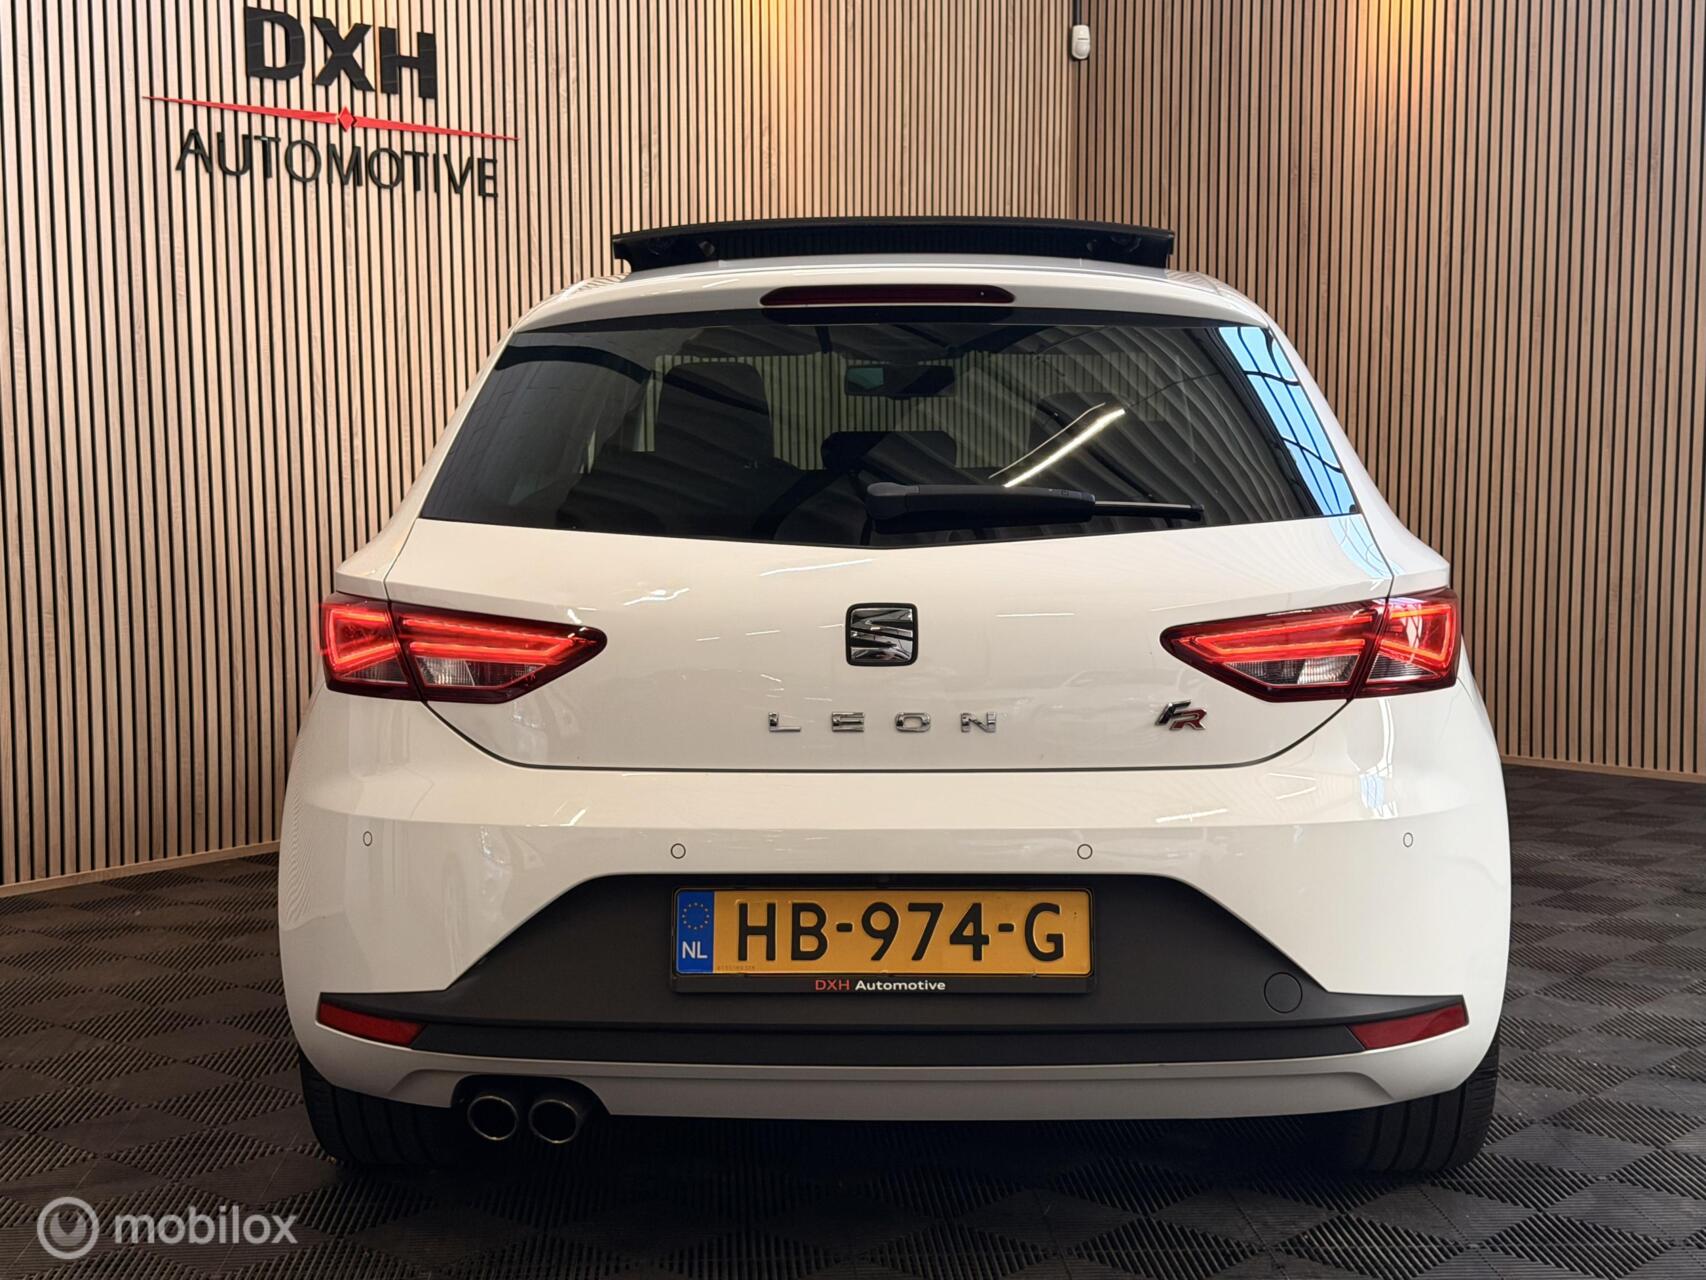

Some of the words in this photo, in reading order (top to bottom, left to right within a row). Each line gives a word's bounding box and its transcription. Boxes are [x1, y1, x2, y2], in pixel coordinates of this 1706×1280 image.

[245, 6, 437, 100] DXH
[176, 128, 498, 199] AUTOMOTIVE
[768, 711, 998, 733] LEON
[1154, 700, 1208, 731] FR
[737, 902, 1065, 962] HB-974-G
[682, 941, 708, 959] NL
[815, 979, 851, 991] DXH
[855, 979, 946, 992] Automotive
